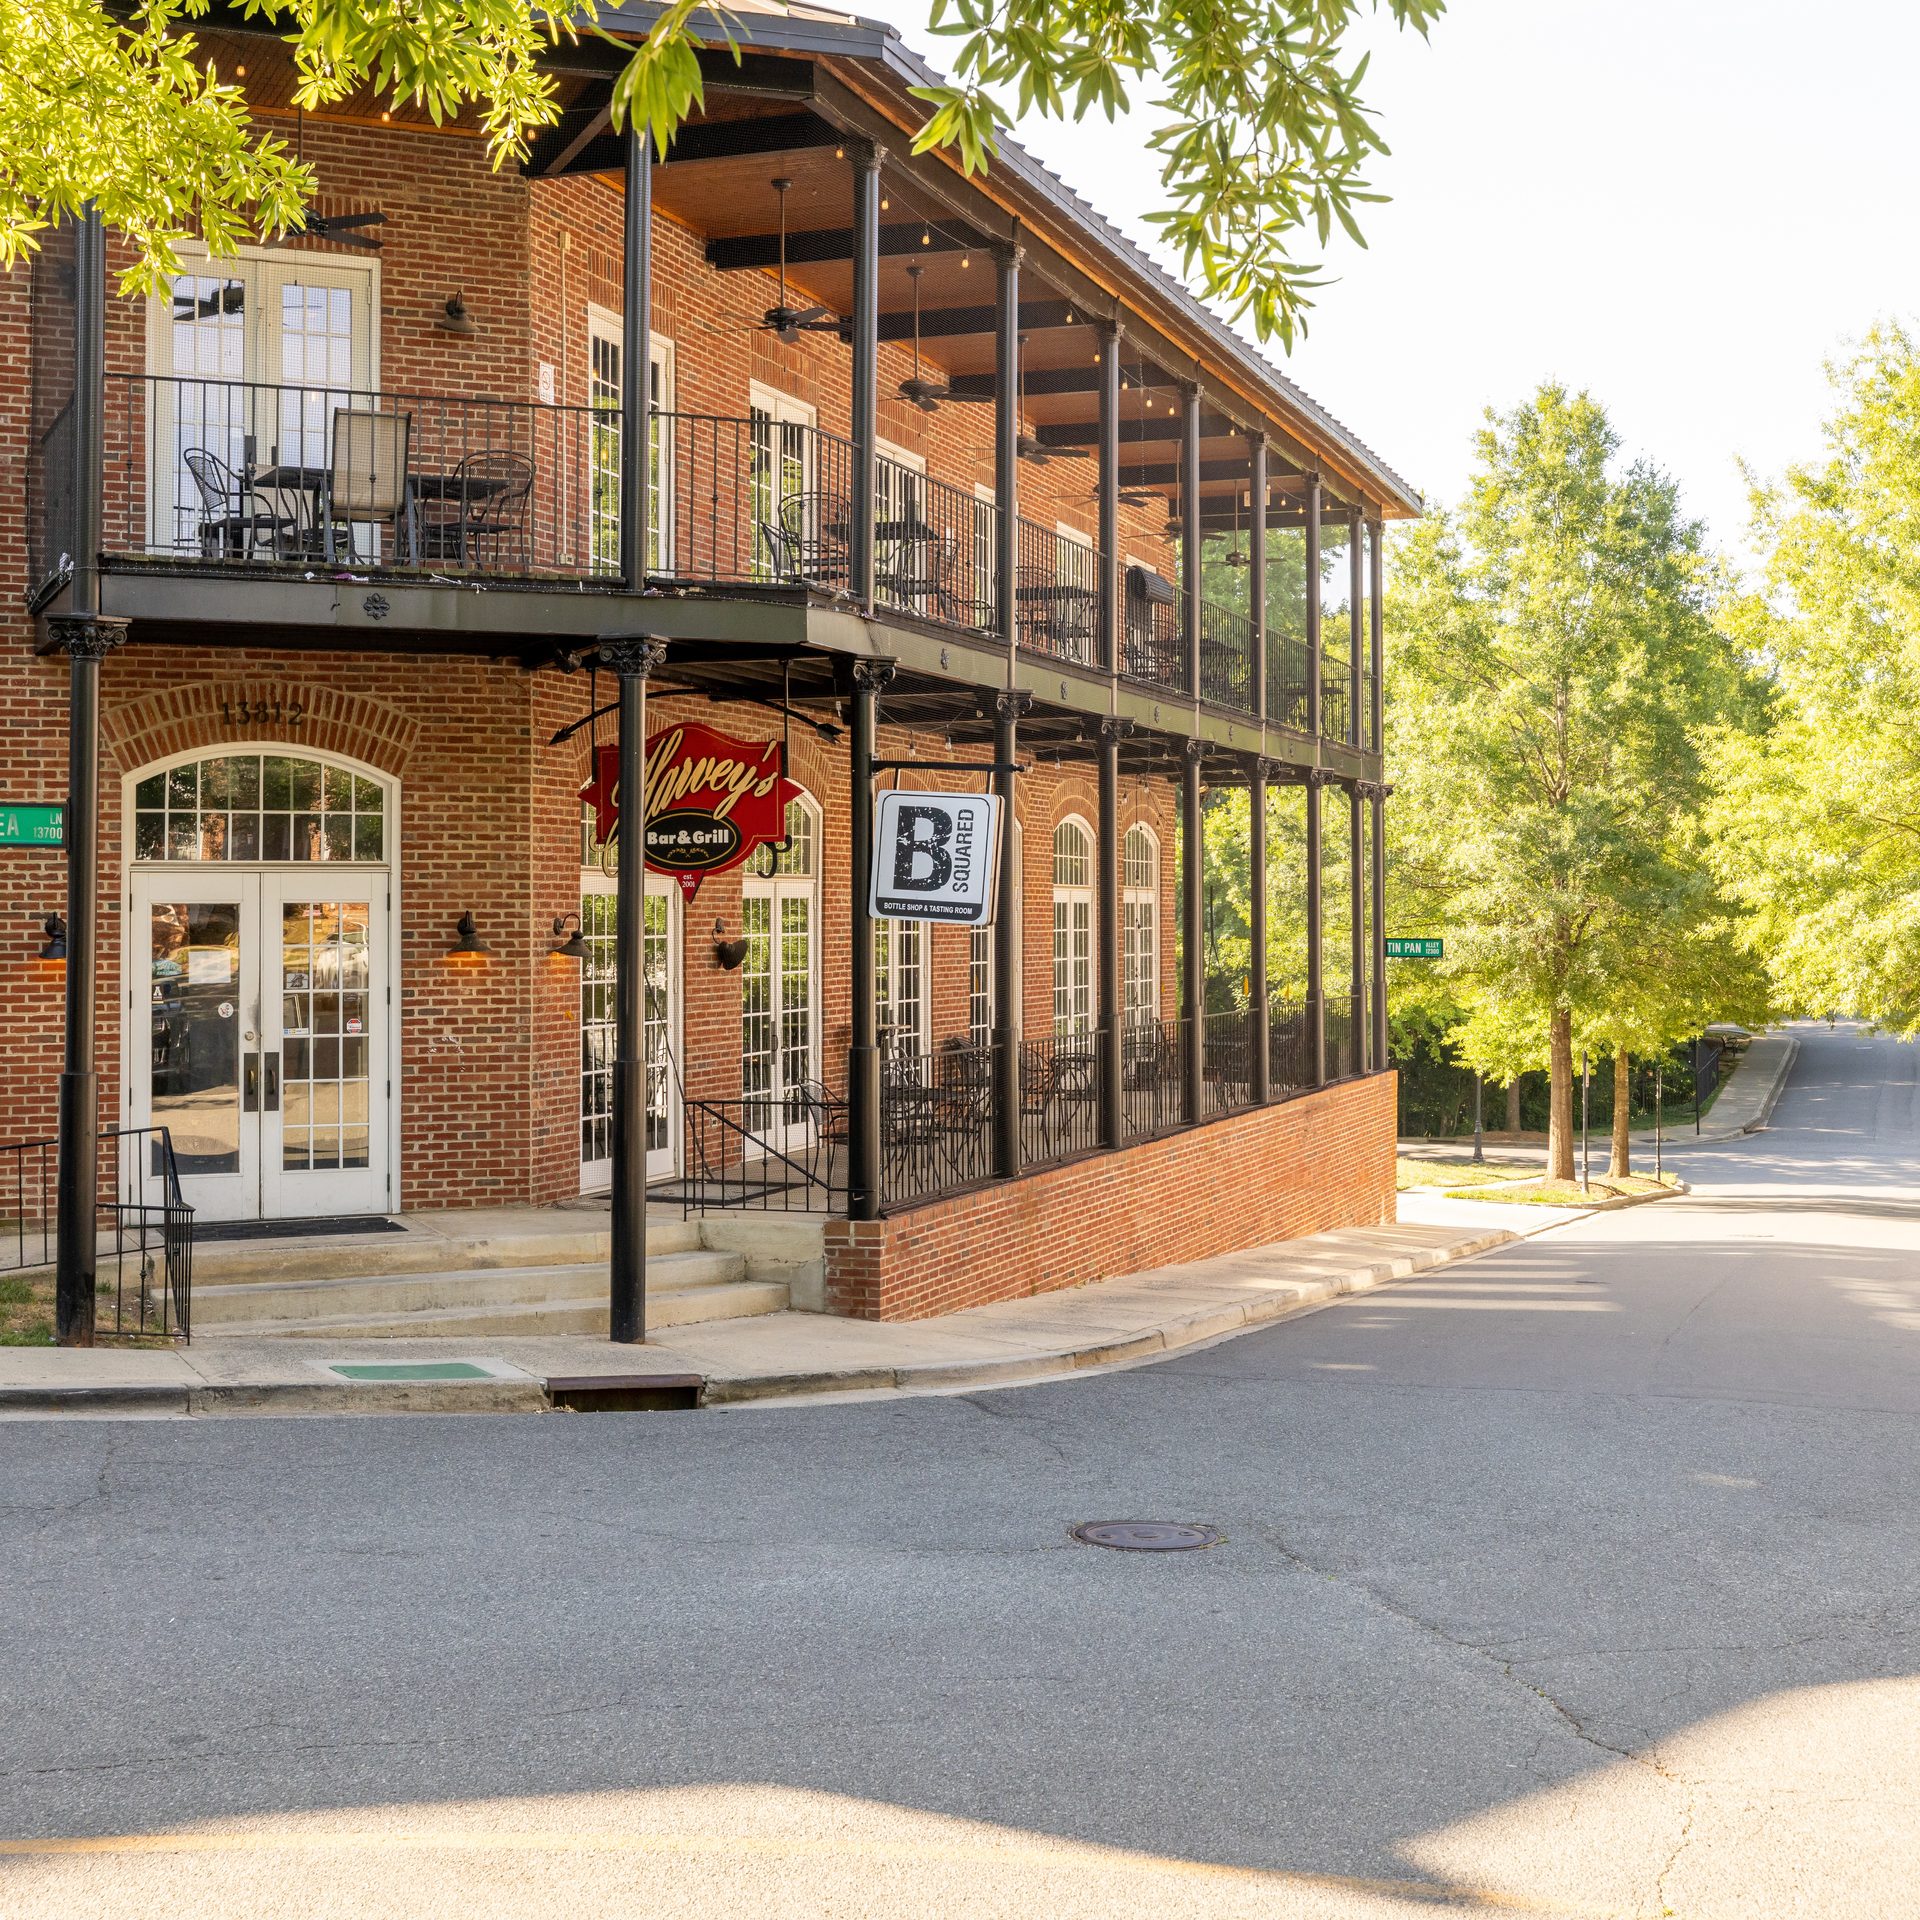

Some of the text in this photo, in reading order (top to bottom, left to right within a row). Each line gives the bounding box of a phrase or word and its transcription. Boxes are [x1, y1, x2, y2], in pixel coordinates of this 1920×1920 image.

[223, 701, 303, 725] 13812
[588, 728, 778, 878] Harvey's
[50, 811, 63, 825] LN
[33, 826, 63, 840] 13700
[893, 805, 953, 892] B
[952, 808, 974, 893] SQUARED
[884, 902, 906, 910] BOTTLE
[930, 905, 954, 913] TASTING
[955, 907, 973, 915] ROOM
[1387, 942, 1421, 953] TIN PAN
